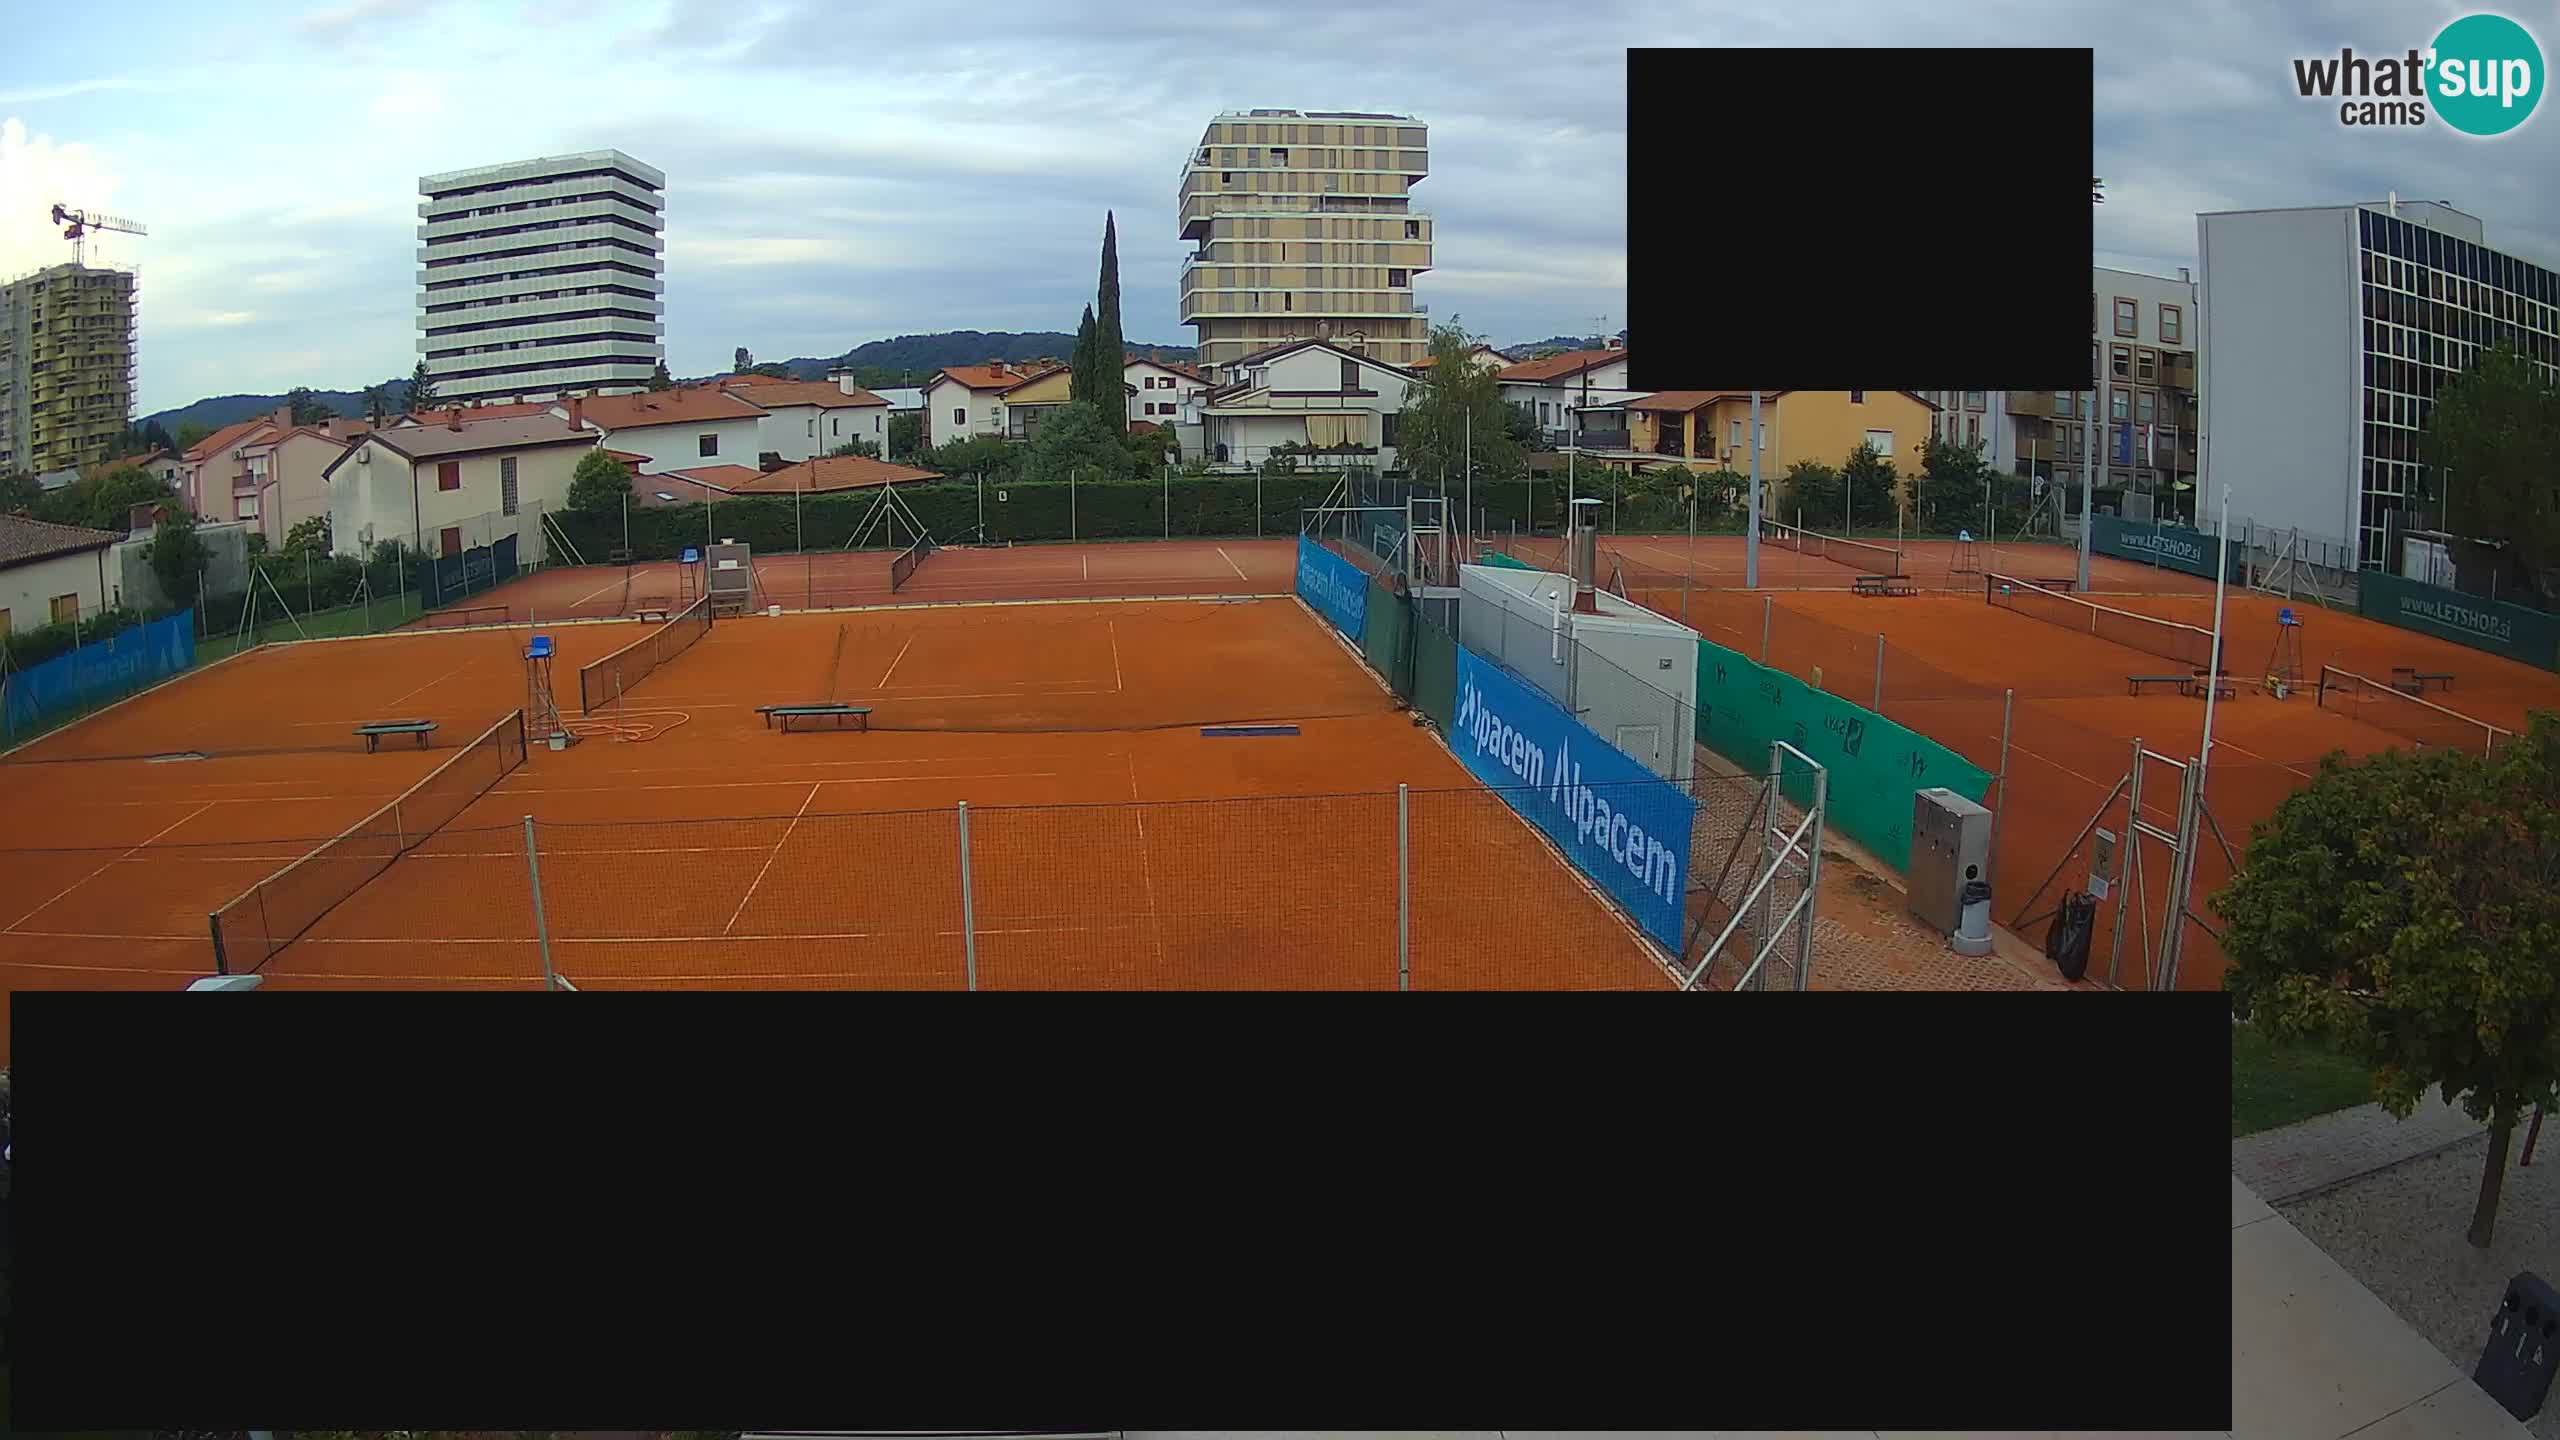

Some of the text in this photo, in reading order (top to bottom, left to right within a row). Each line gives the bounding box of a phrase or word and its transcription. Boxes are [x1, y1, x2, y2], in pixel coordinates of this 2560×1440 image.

[2400, 595, 2512, 638] www.LETSHOP.si
[1457, 670, 1677, 905] Alpacem Alpacem
